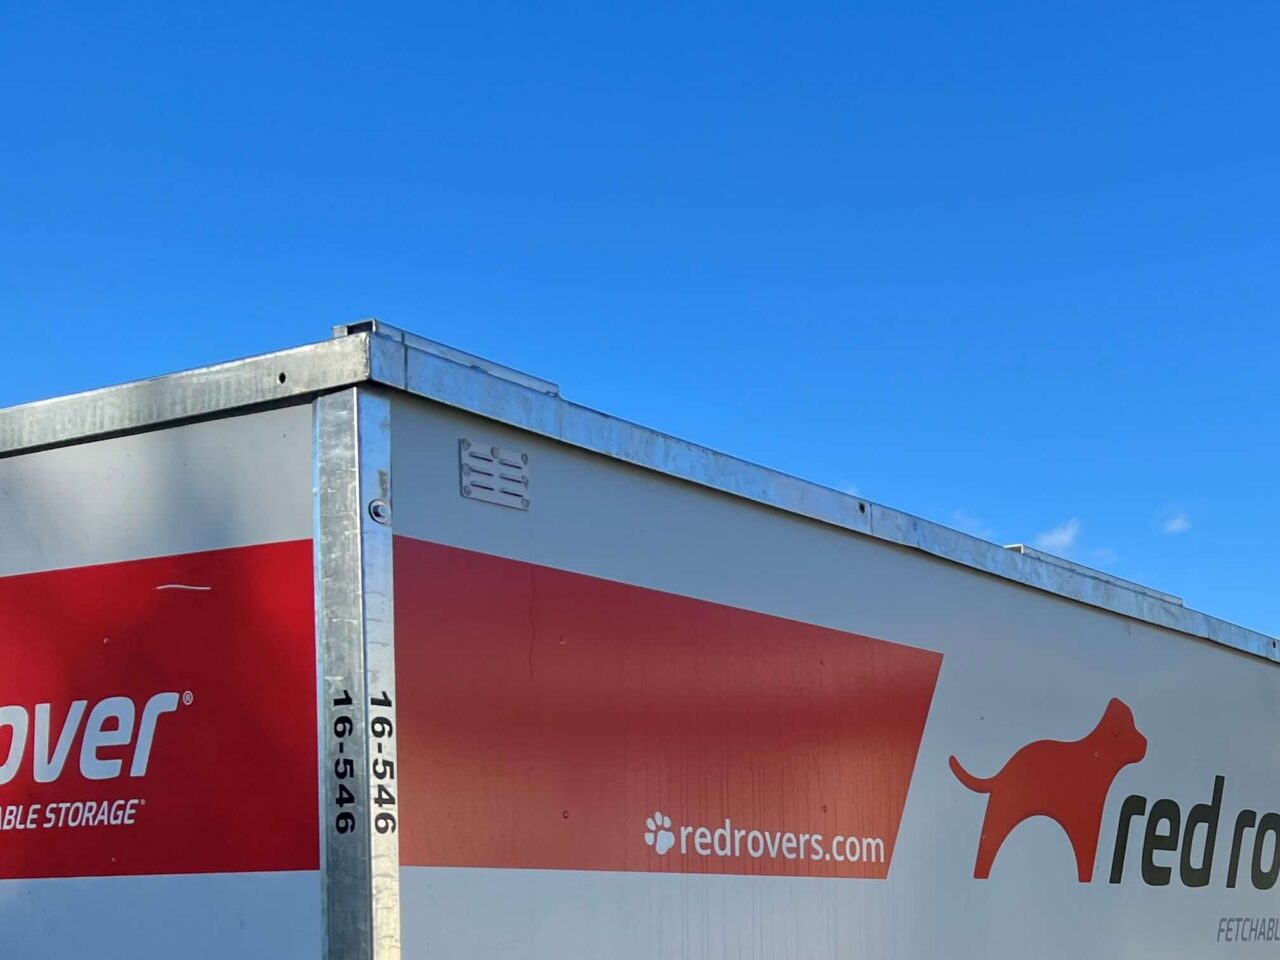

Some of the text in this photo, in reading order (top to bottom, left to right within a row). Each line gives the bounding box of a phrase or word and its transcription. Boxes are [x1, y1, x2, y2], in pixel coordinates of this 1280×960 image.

[0, 800, 139, 830] BLE STORAGE
[333, 690, 356, 834] 16-546
[370, 690, 397, 834] 16-546
[680, 818, 885, 863] redrovers.com
[1109, 775, 1226, 888] red
